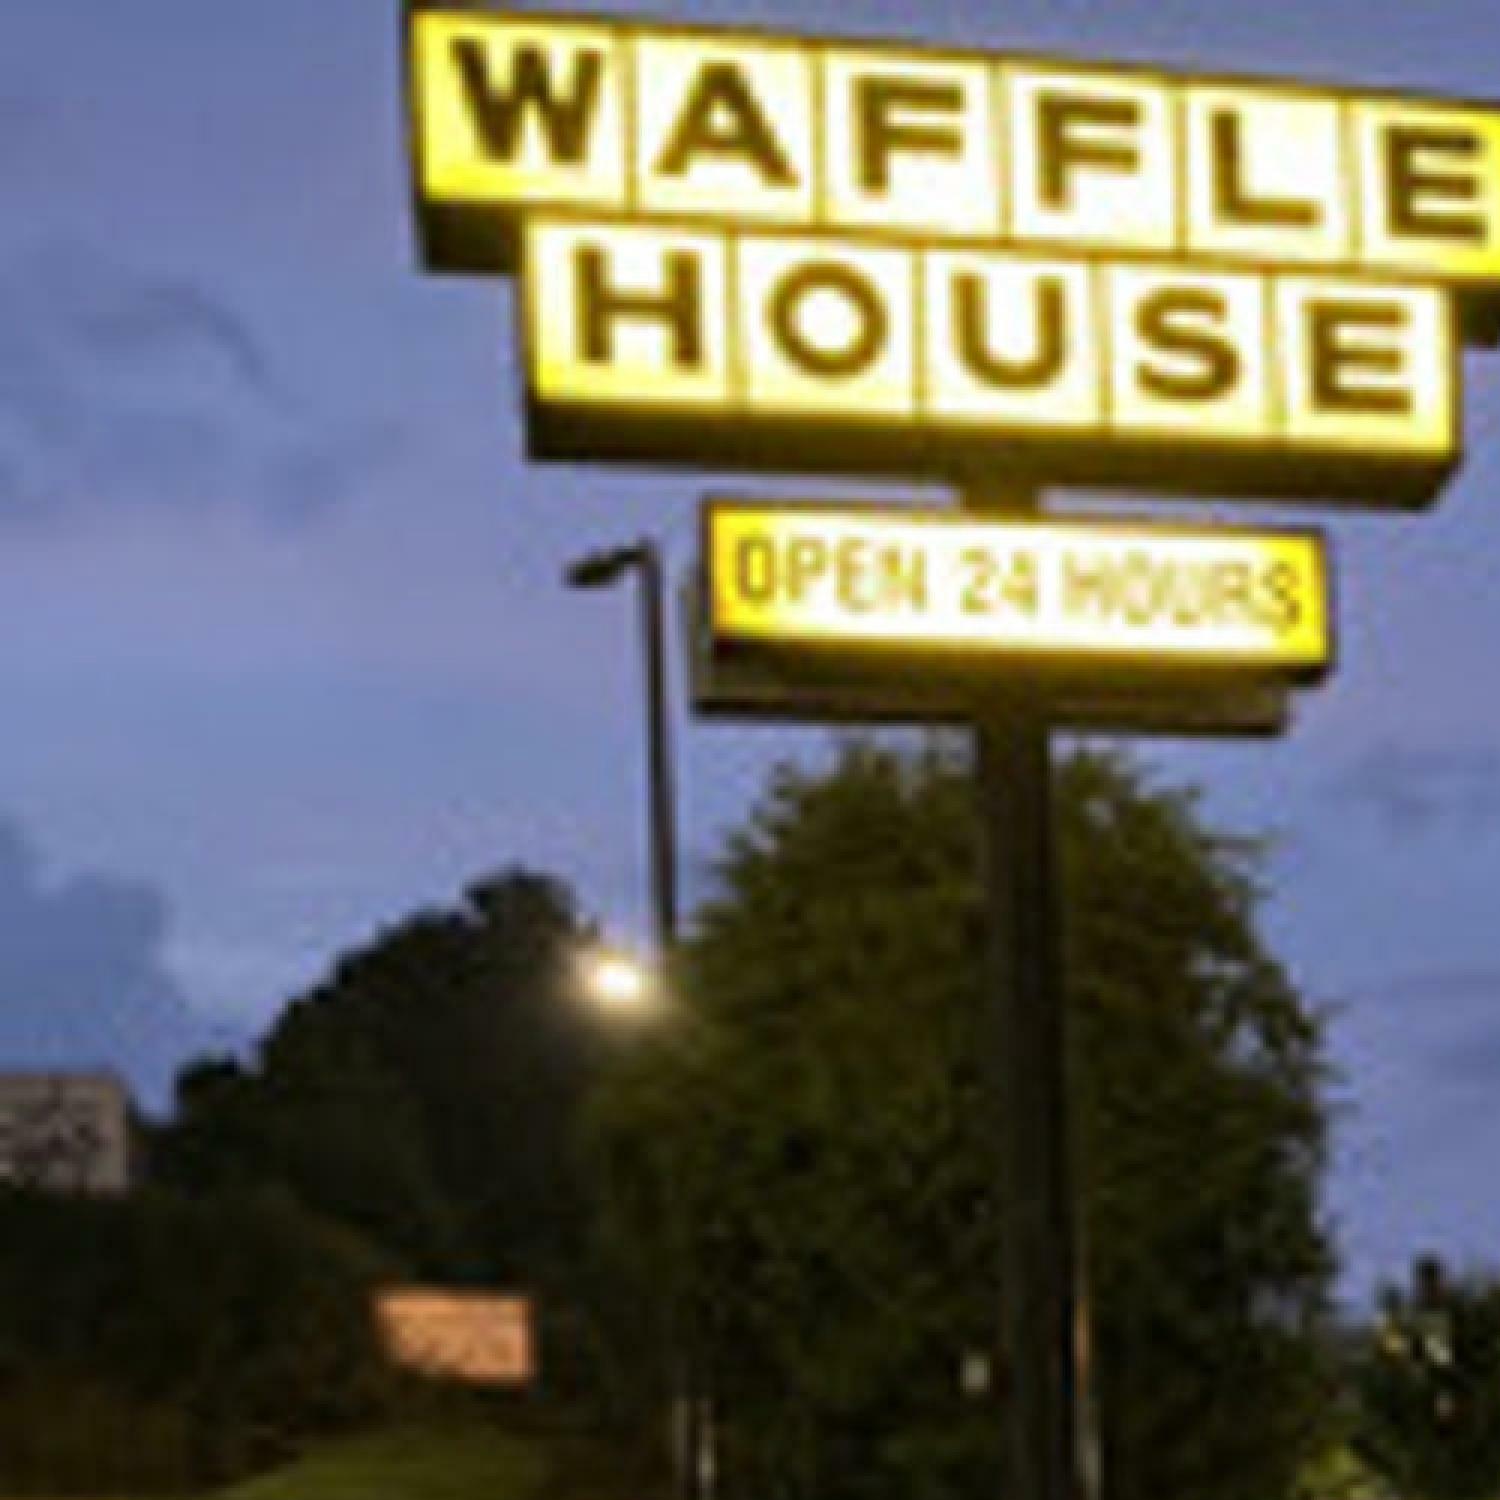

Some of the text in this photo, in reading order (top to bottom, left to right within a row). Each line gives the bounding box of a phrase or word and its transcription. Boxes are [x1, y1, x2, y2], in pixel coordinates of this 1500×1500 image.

[450, 37, 1490, 244] WAFFLE
[571, 245, 1416, 414] HOUSE
[735, 532, 1302, 632] OPEN 24 HOURS
